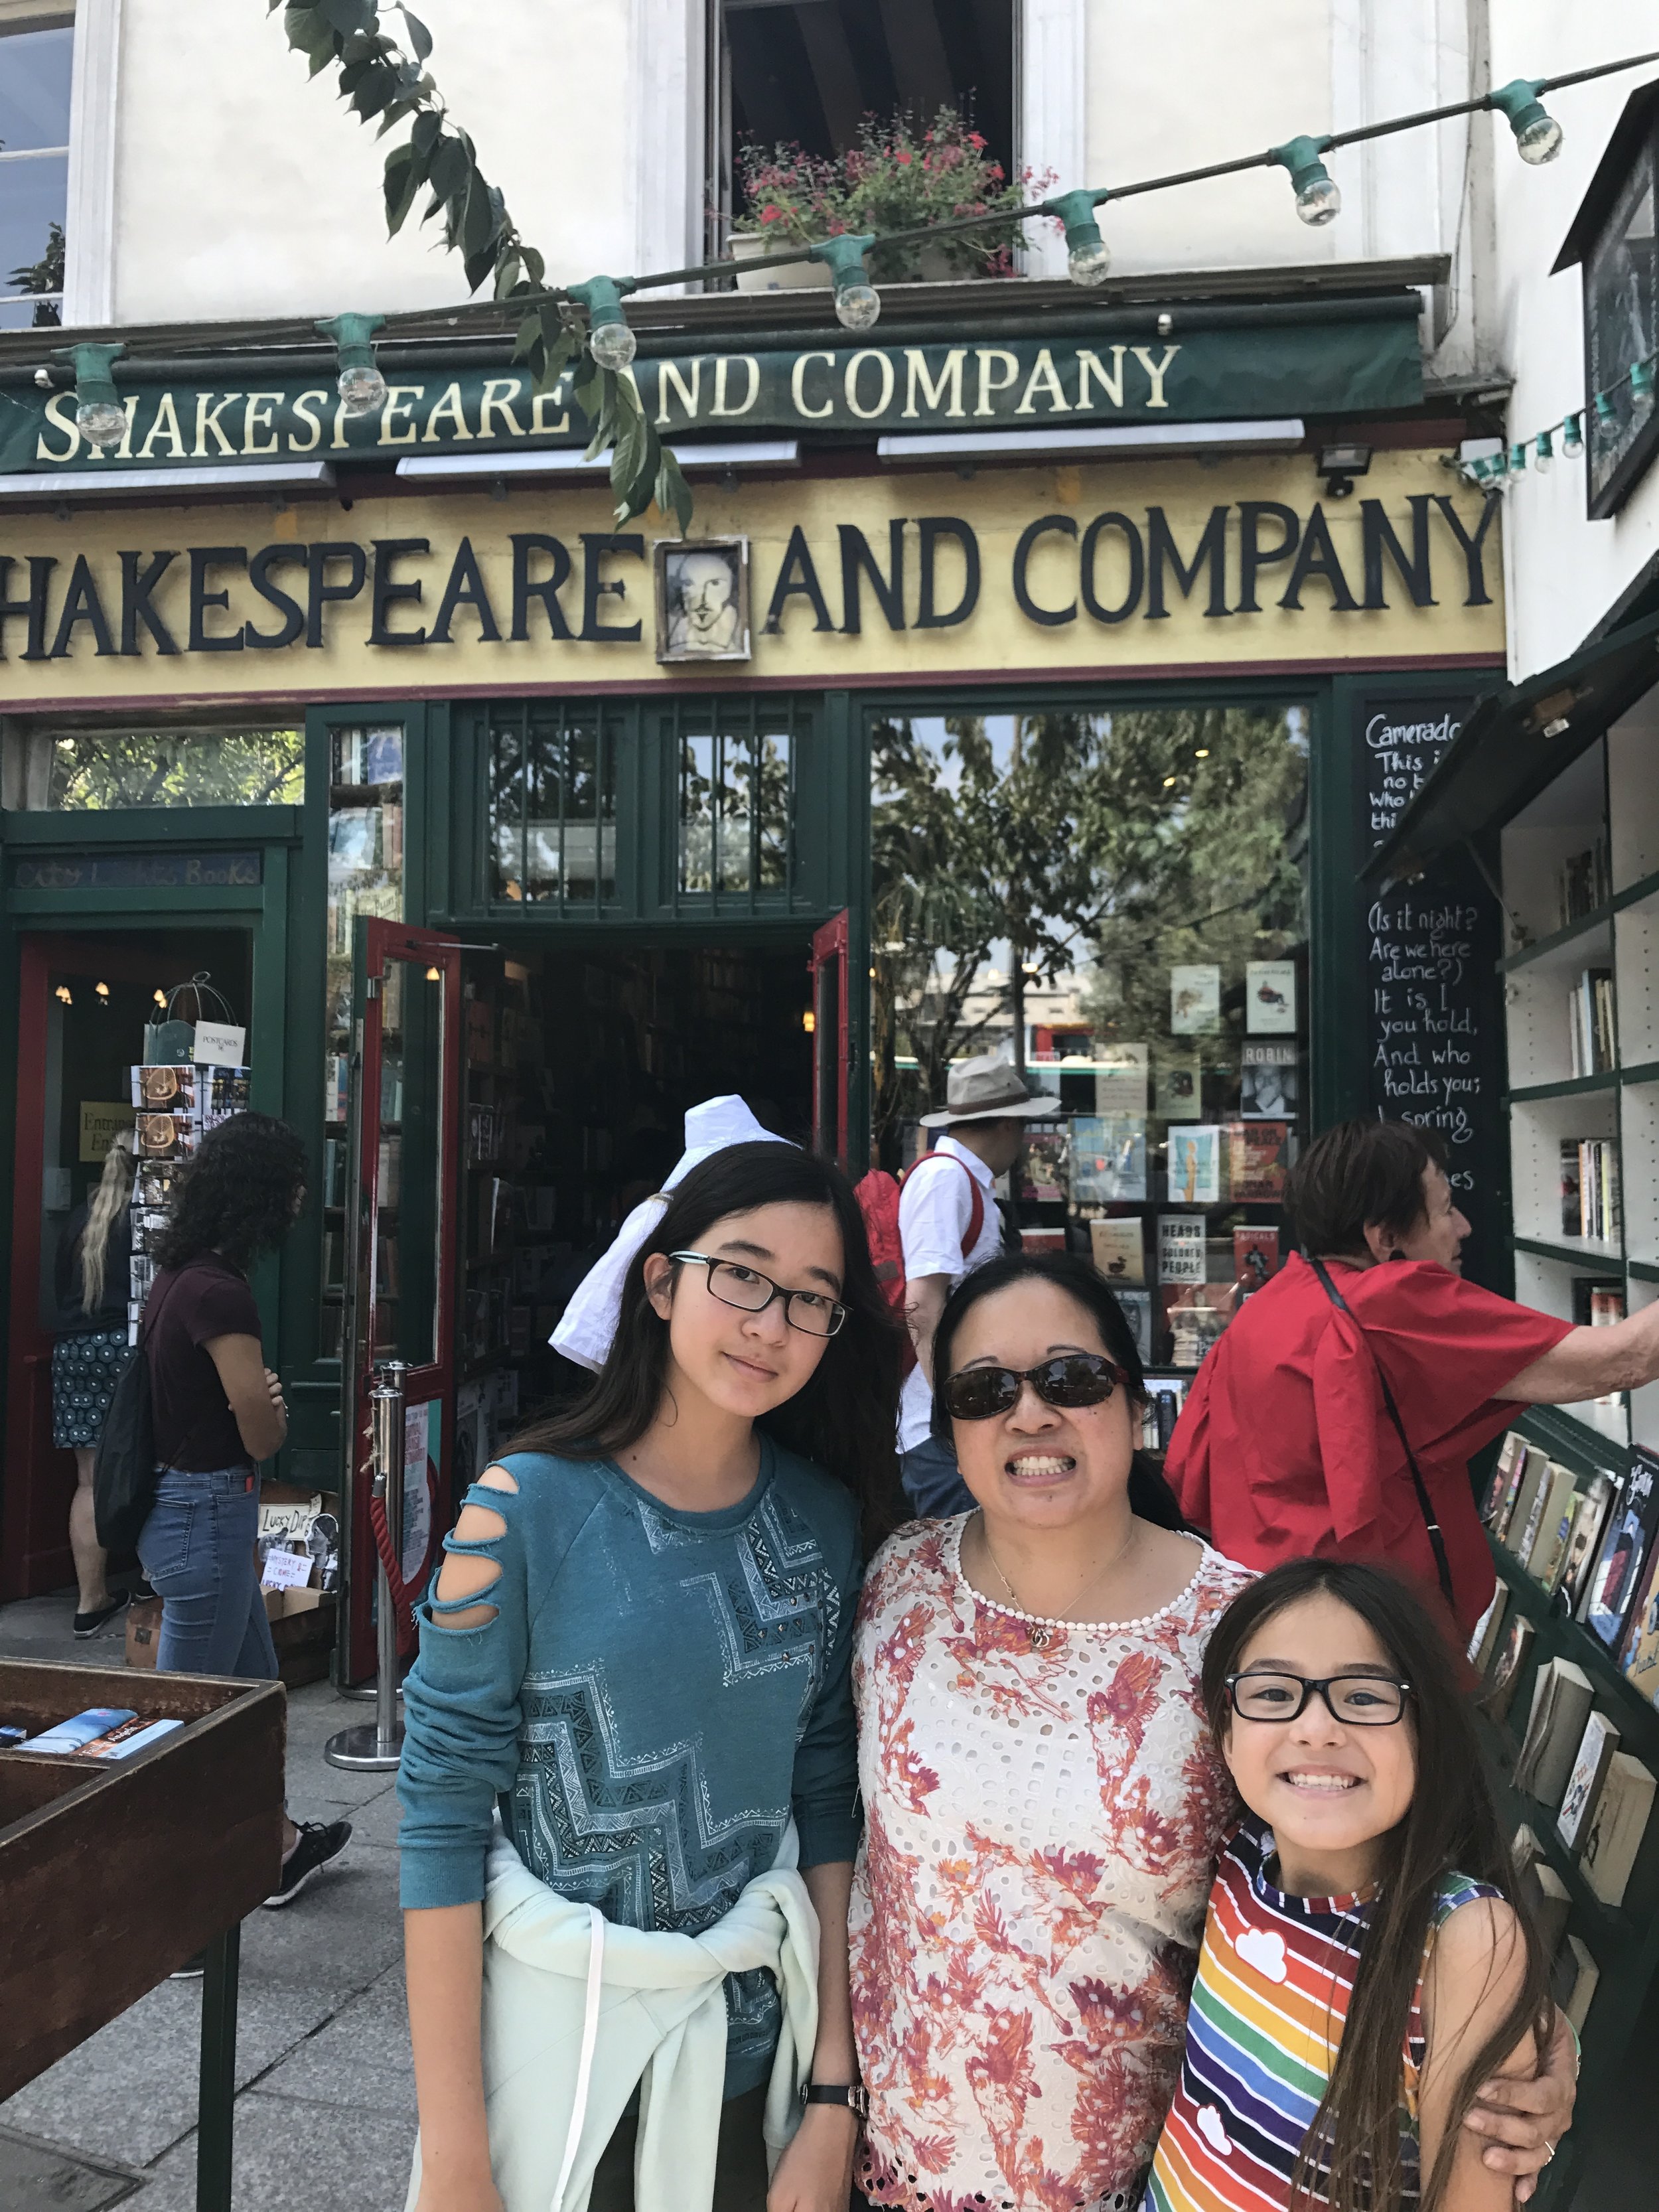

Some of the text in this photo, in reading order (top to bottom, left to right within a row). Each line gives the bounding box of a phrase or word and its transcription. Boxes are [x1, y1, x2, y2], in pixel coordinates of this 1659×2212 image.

[795, 344, 1183, 419] COMPANY
[762, 516, 981, 636] AND
[1013, 489, 1503, 626] COMPANY
[1374, 750, 1423, 774] This
[1383, 775, 1407, 789] no
[1397, 902, 1413, 931] it
[1418, 904, 1478, 940] night?
[1369, 936, 1471, 962] Are we here
[1374, 982, 1449, 1015] It is I
[1376, 1007, 1478, 1043] you hold,
[1373, 1038, 1471, 1068] And who
[1384, 1068, 1481, 1106] holds you;
[1401, 1105, 1473, 1143] spring
